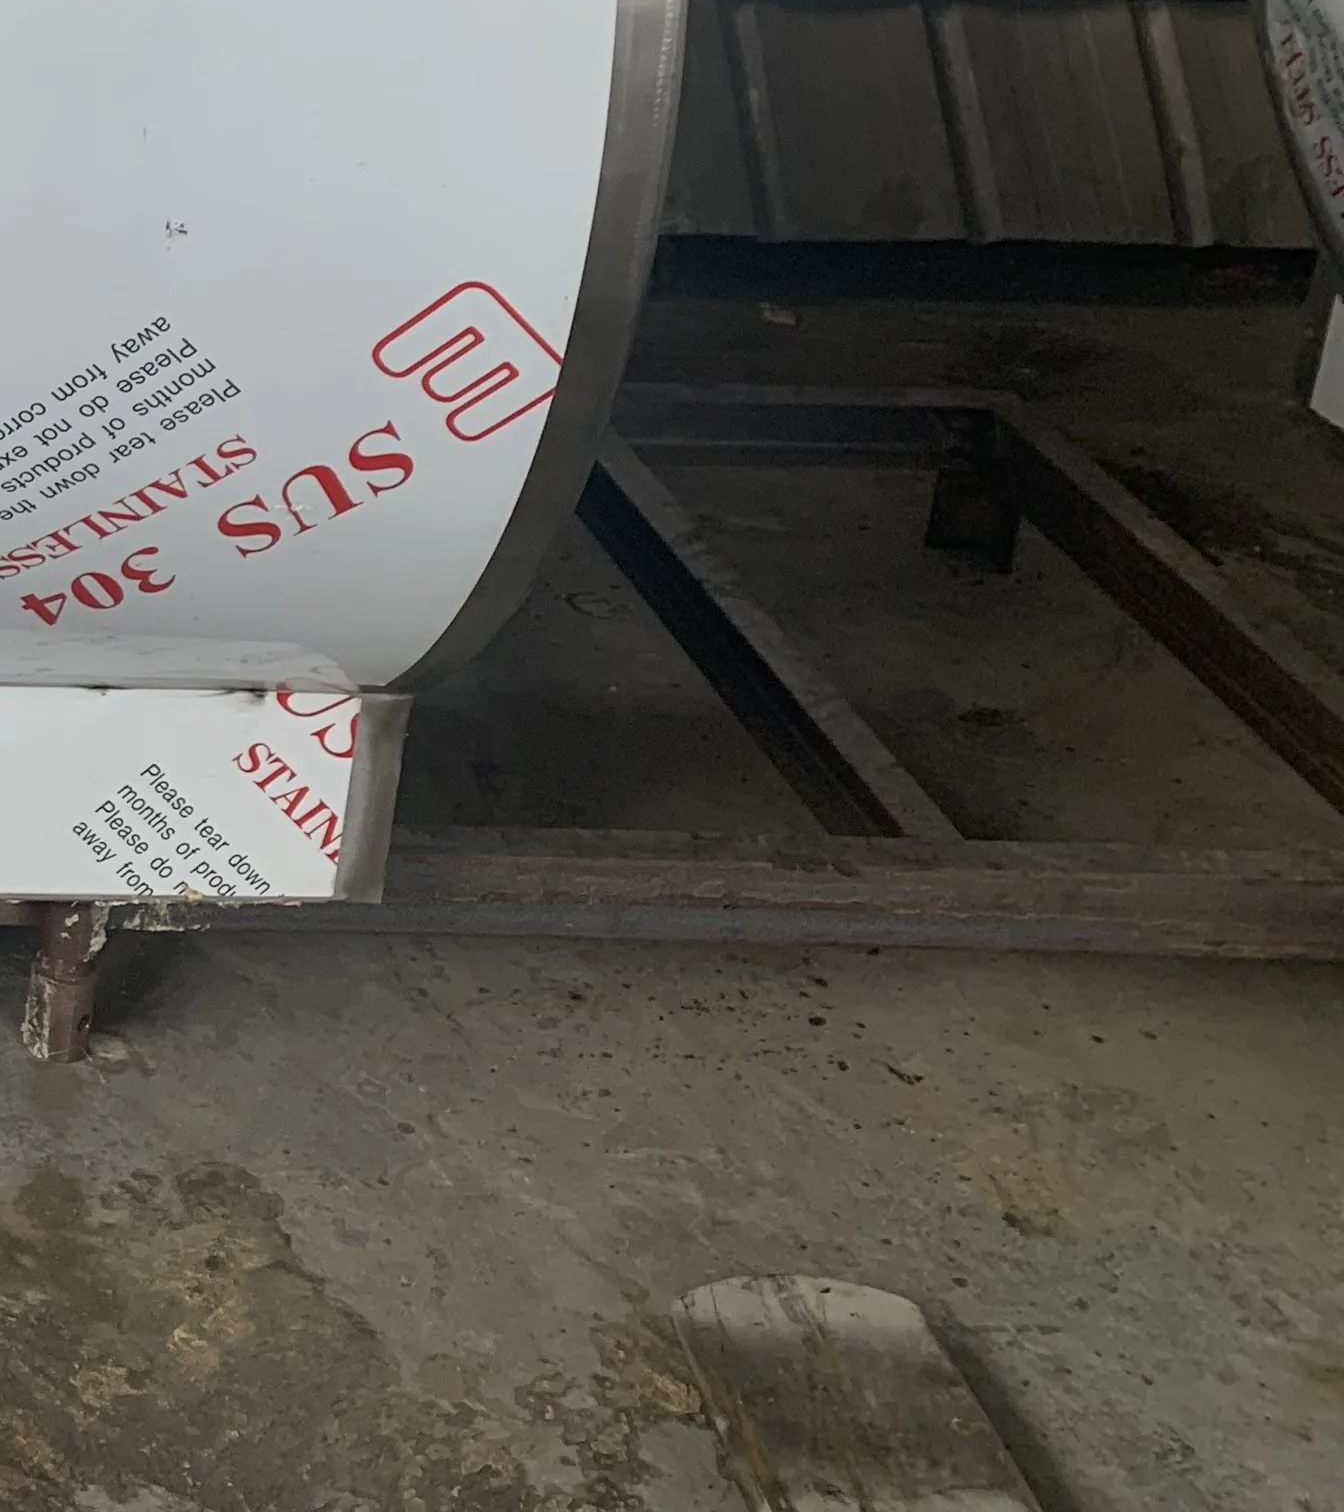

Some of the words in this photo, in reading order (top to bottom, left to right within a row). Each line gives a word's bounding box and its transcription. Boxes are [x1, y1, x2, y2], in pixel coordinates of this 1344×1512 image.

[109, 315, 172, 365] away
[115, 336, 199, 394] Please
[49, 362, 109, 403] from
[77, 394, 110, 418] do
[31, 417, 74, 448] not
[216, 422, 416, 558] SUS
[21, 543, 176, 626] 304
[94, 799, 150, 856] Please
[149, 856, 174, 880] do
[116, 783, 177, 842] months
[174, 841, 202, 861] of
[139, 762, 196, 819] Please
[193, 817, 231, 853] tear
[227, 852, 272, 897] down
[231, 742, 344, 866] STAIN
[71, 820, 118, 864] away
[115, 860, 155, 897] from
